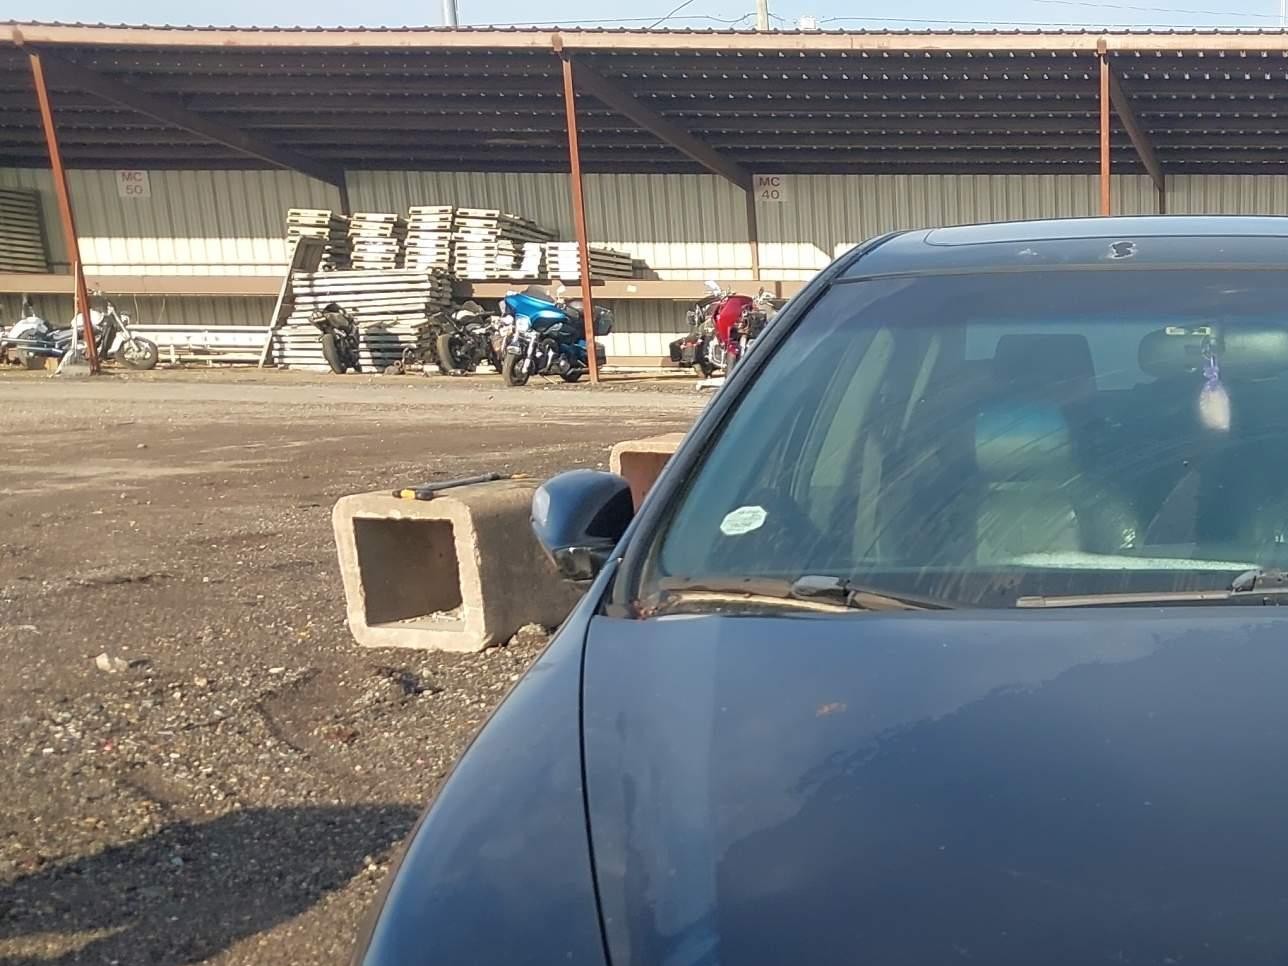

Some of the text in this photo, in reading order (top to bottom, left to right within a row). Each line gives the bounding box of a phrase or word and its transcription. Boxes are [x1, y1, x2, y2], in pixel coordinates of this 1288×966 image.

[121, 171, 142, 182] MC
[759, 176, 780, 187] MC
[126, 184, 143, 195] 50
[761, 189, 780, 200] 40
